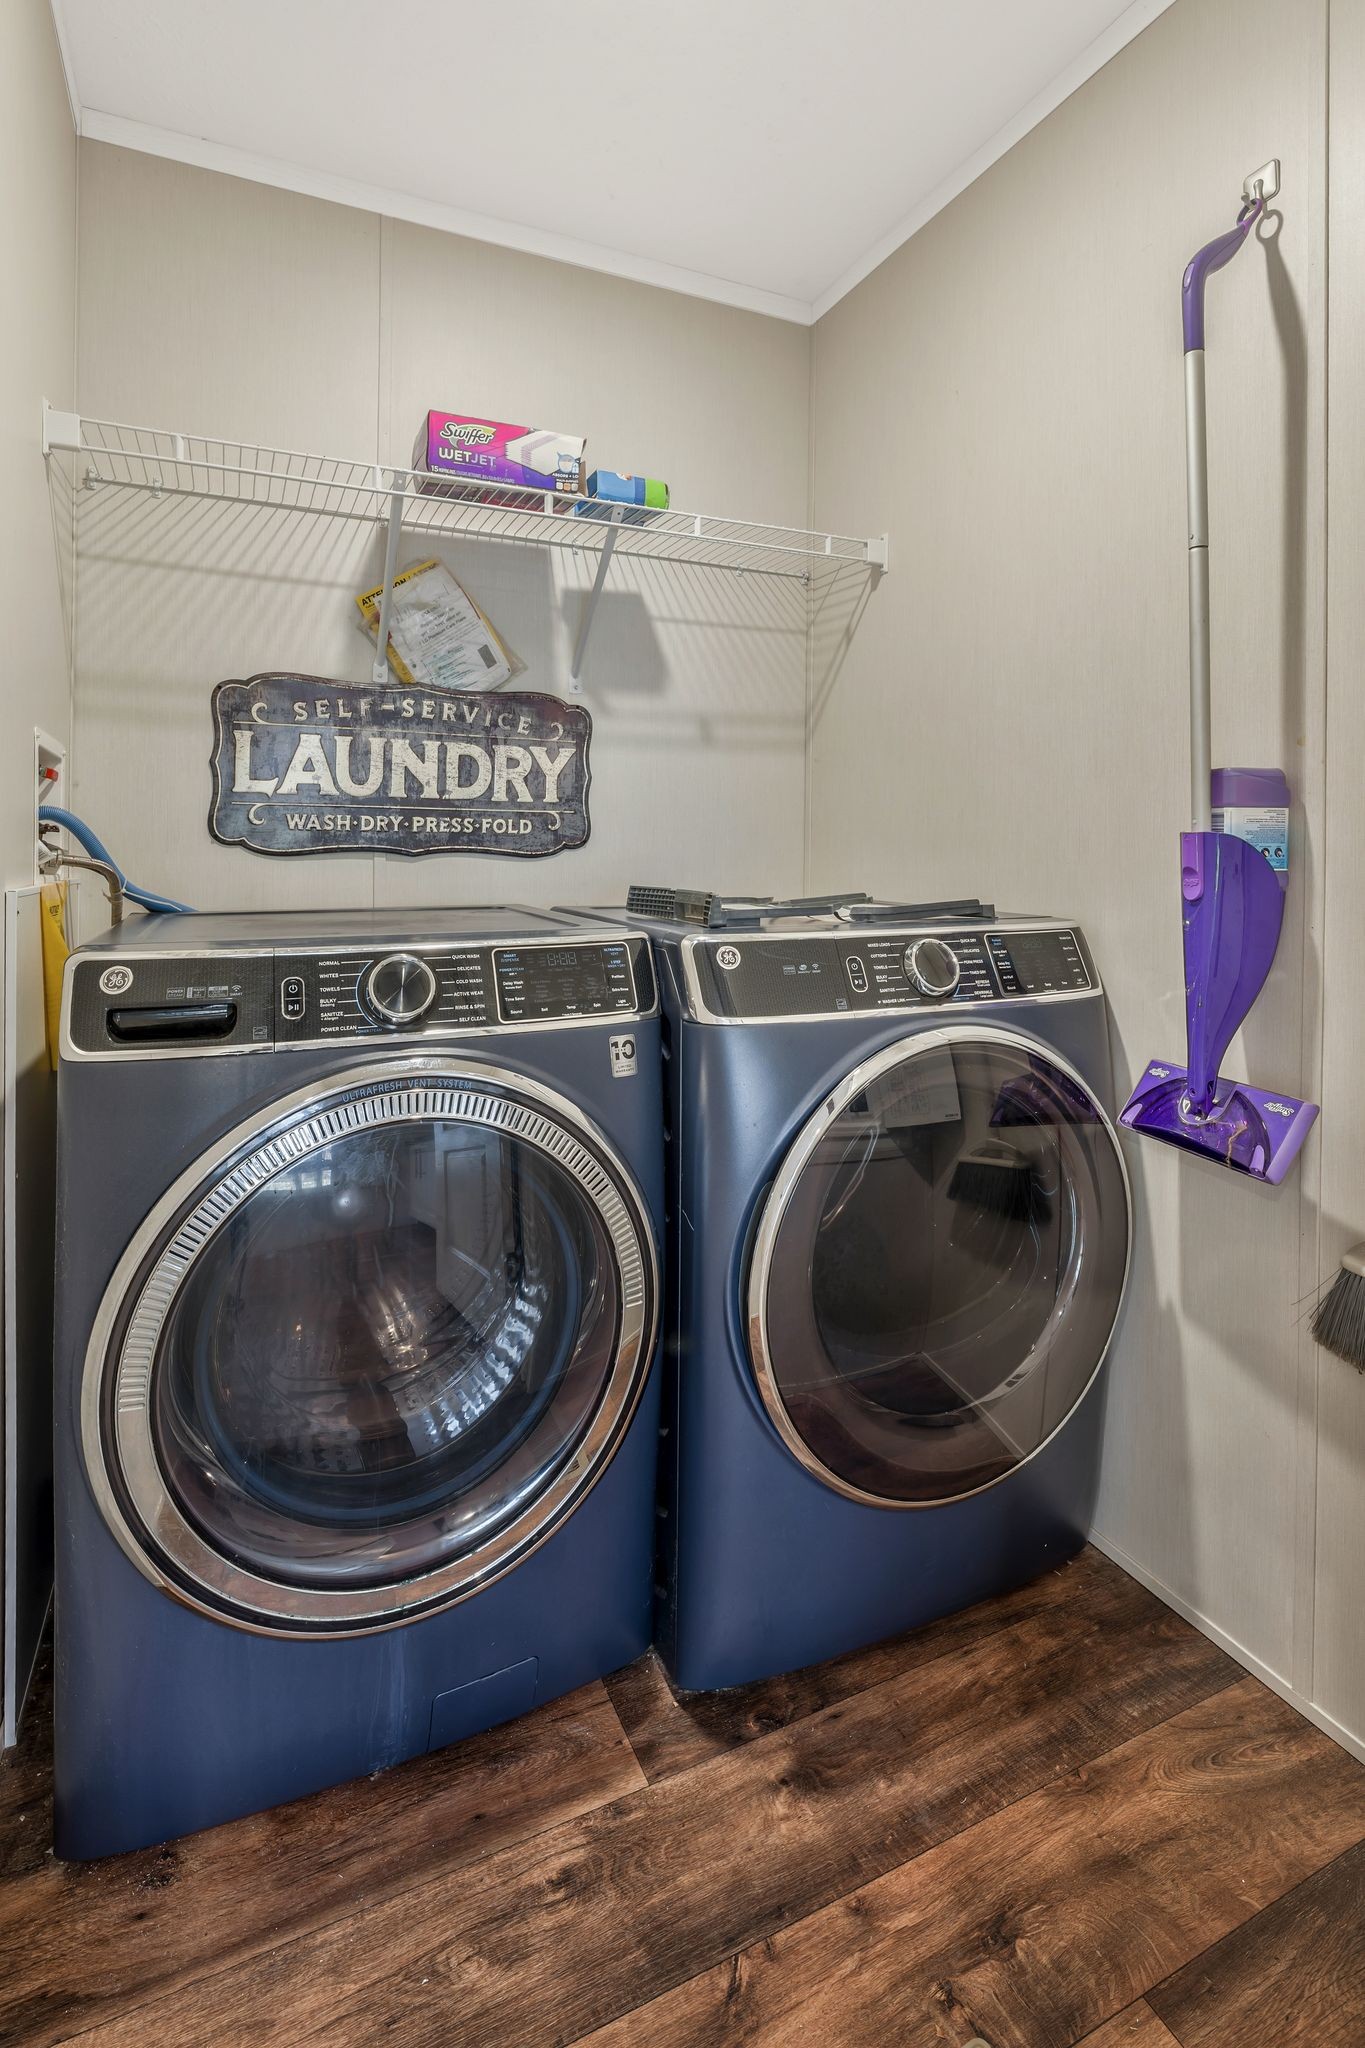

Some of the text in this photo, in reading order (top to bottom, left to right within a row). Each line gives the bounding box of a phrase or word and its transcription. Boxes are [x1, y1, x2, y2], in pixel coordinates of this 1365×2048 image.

[440, 422, 494, 445] Swiffer
[439, 447, 496, 467] WETJET
[293, 698, 532, 736] SELF-SERVICE
[232, 730, 577, 803] LAUNDRY
[611, 1040, 635, 1060] 10
[341, 1079, 473, 1102] ULTRAFRESH VENT SYSTEM
